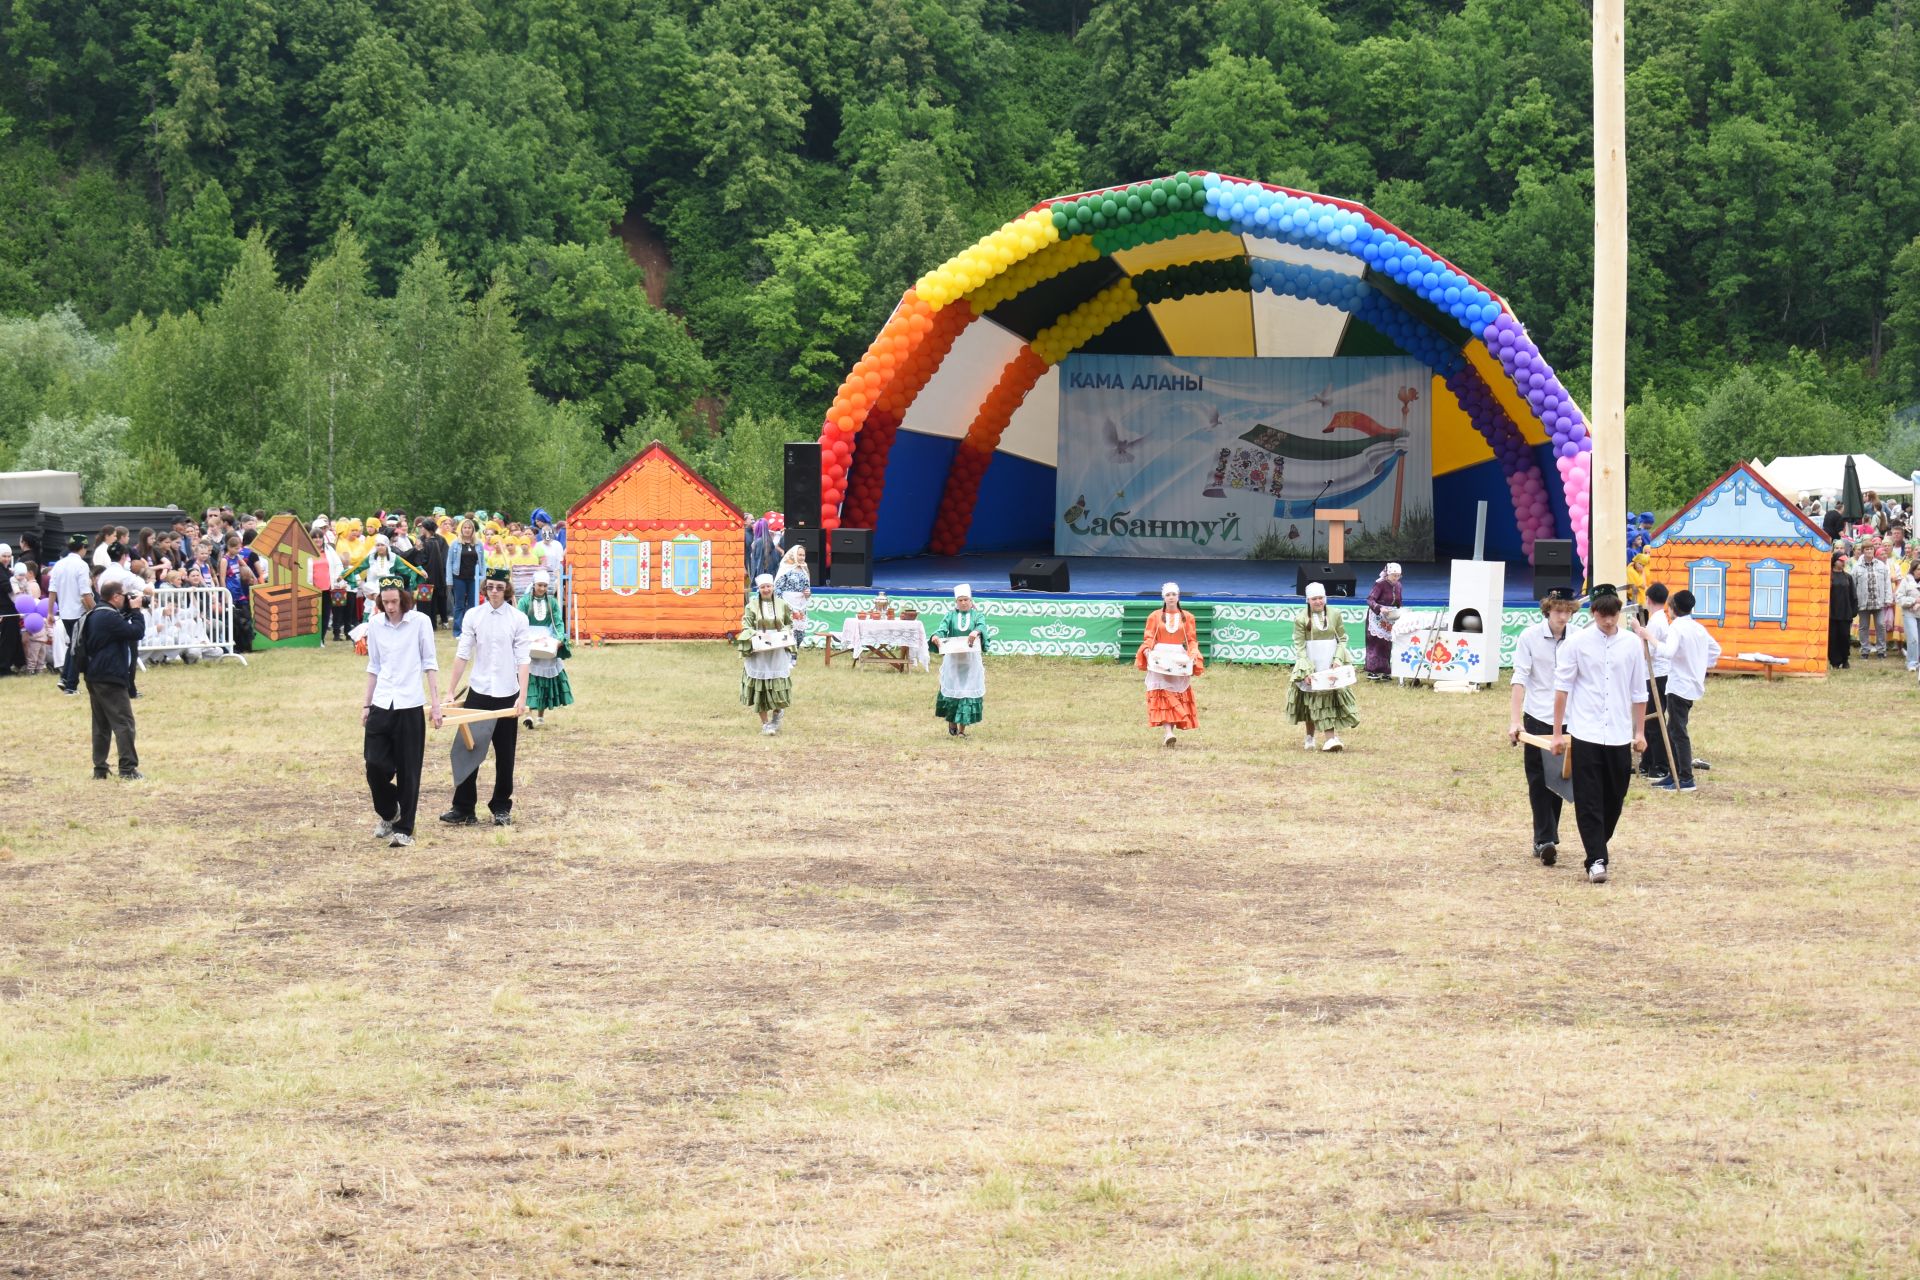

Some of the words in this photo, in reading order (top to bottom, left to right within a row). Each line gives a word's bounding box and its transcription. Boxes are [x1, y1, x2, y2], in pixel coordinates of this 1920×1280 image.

[1070, 372, 1125, 390] КАМА
[1131, 374, 1203, 391] АЛАНЫ
[1065, 505, 1242, 546] Сабантуй
